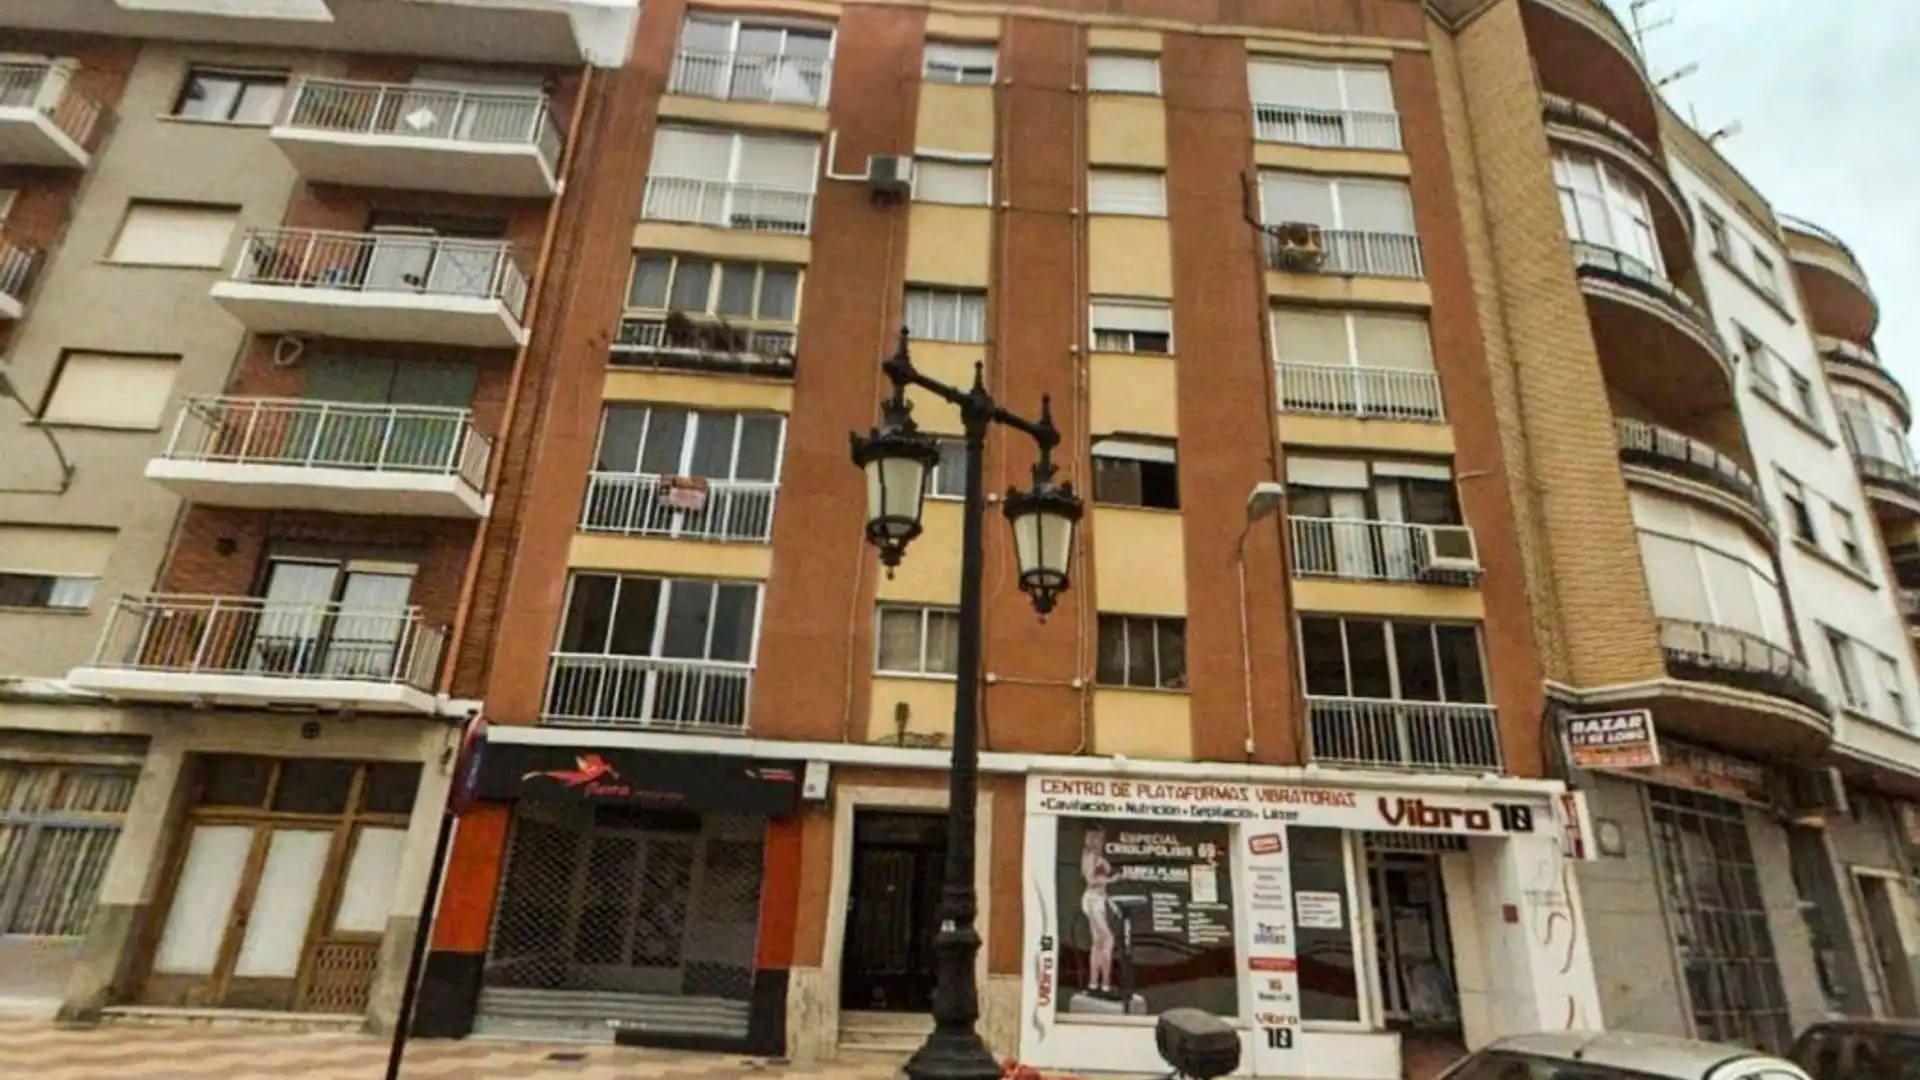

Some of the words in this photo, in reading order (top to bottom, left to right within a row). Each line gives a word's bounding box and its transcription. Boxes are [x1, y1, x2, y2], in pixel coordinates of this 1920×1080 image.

[1571, 715, 1642, 734] BAZAR
[1040, 778, 1105, 796] CENTRO
[1111, 782, 1132, 798] DE
[1137, 783, 1249, 801] PLATAFORMAS
[1255, 785, 1357, 808] VIBRATORIAS
[1377, 797, 1490, 830] Vibro
[1492, 803, 1534, 832] 10
[1119, 831, 1180, 846] ESPECIAL
